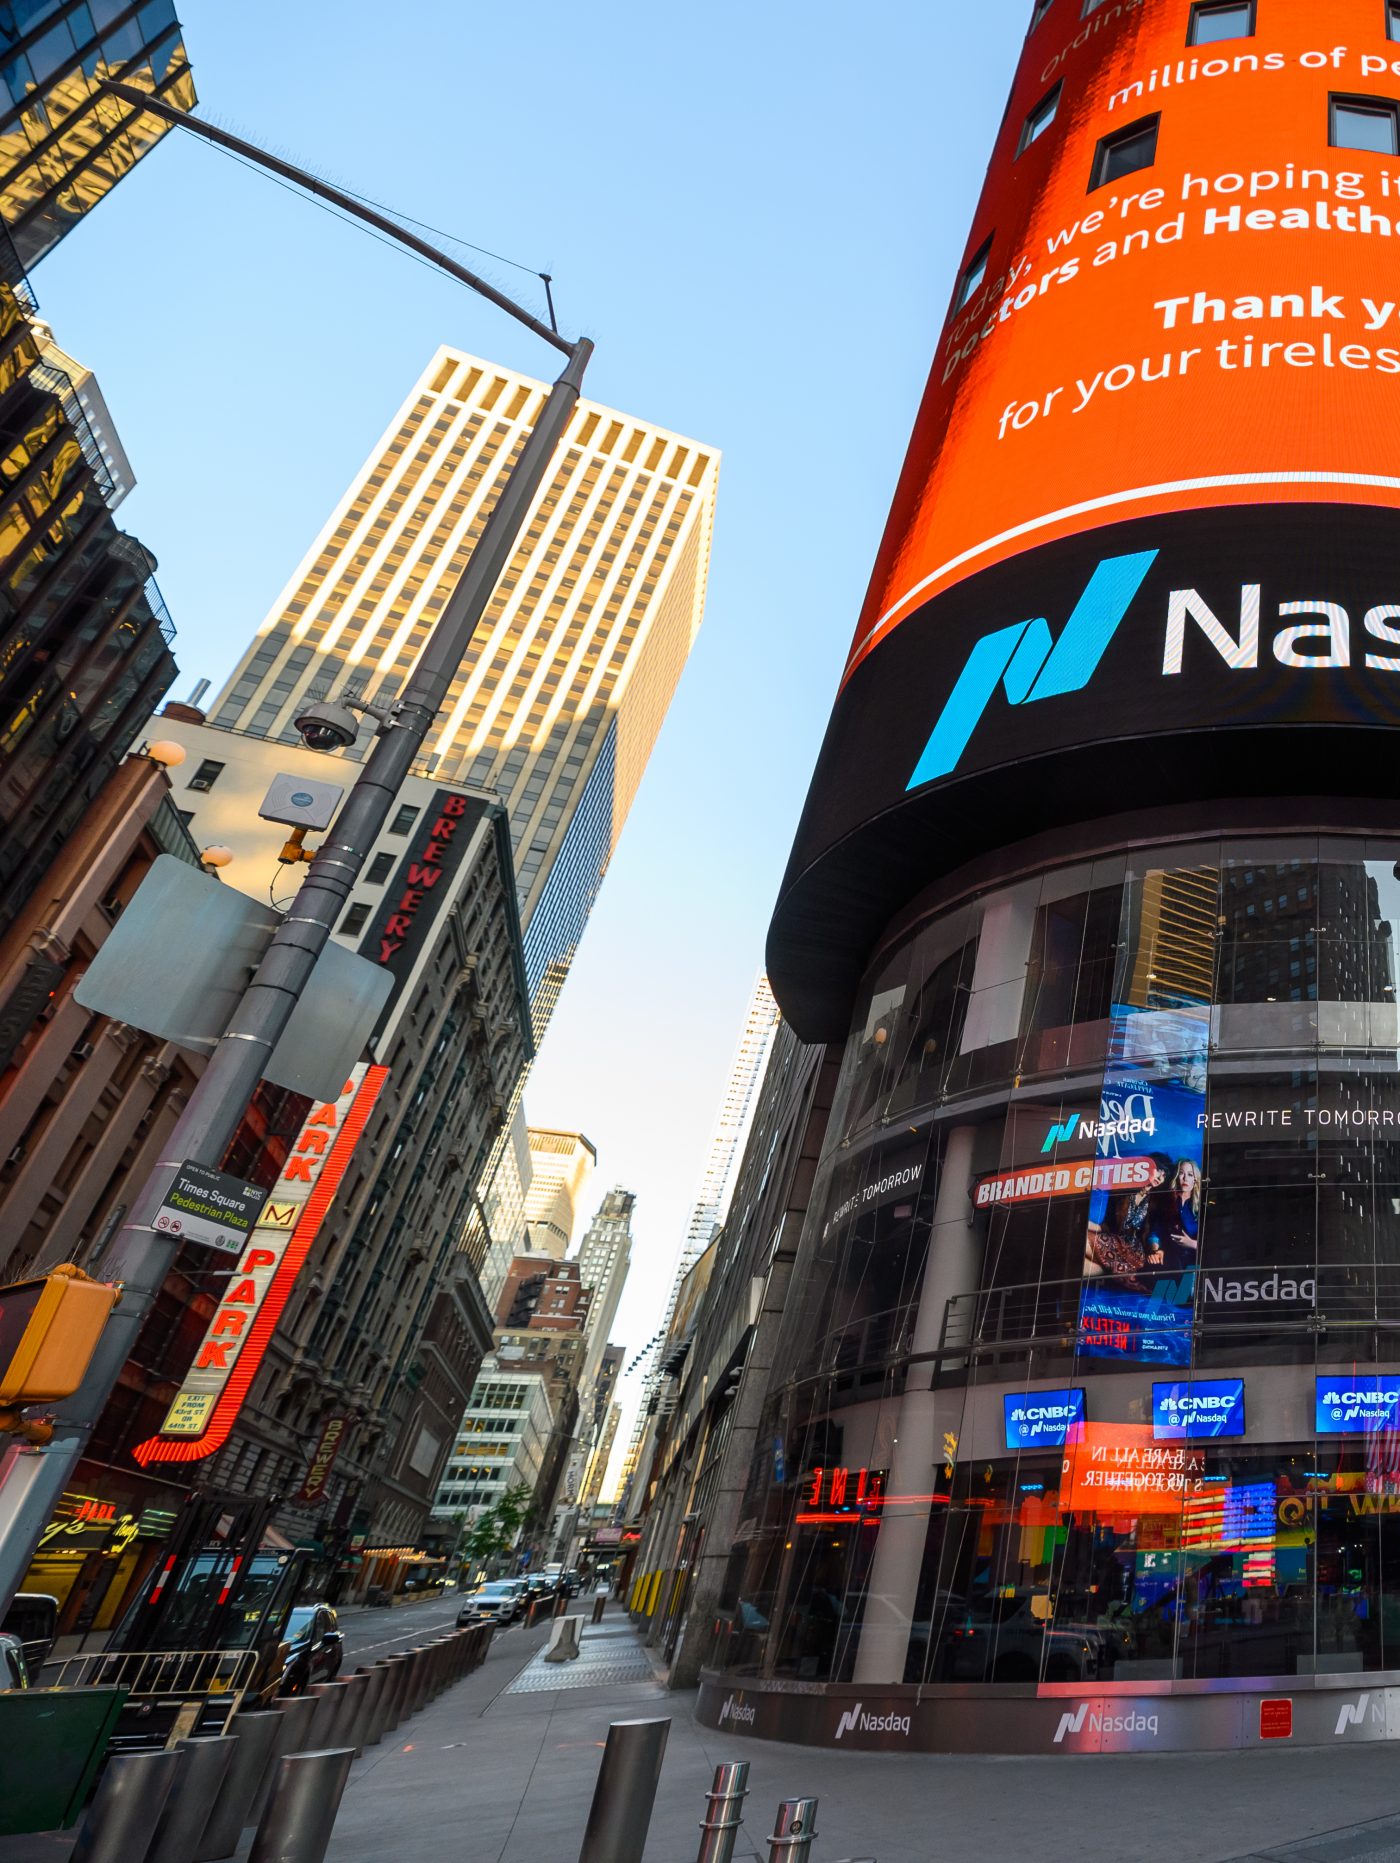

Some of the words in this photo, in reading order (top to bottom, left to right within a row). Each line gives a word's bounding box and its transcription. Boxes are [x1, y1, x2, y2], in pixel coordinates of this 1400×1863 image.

[1107, 52, 1285, 112] millions
[1300, 46, 1350, 69] of
[1046, 186, 1165, 254] we're
[1181, 162, 1366, 200] hoping
[941, 257, 1080, 387] Doctors
[1092, 212, 1185, 267] and
[1153, 285, 1346, 329] Thank
[997, 385, 1064, 440] for
[1073, 344, 1202, 413] your
[377, 794, 468, 966] BREWERY
[1078, 1116, 1156, 1140] Nasdaq
[1196, 1110, 1292, 1129] REWRITE
[186, 1164, 199, 1173] OPEN
[205, 1171, 221, 1181] PUBLIC
[862, 1164, 922, 1202] TOMORROW
[976, 1168, 1070, 1205] BRANDED
[1074, 1161, 1151, 1188] CITIES
[169, 1192, 223, 1219] Pedestrian
[223, 1210, 249, 1228] Plaza
[178, 1177, 209, 1198] Times
[209, 1190, 246, 1212] Square
[1204, 1273, 1316, 1308] Nasdaq
[196, 1249, 275, 1368] PARK
[1026, 1405, 1077, 1420] CNBC
[1177, 1395, 1236, 1410] CNBC
[1339, 1391, 1399, 1404] CNBC
[1359, 1408, 1390, 1419] Nasdaq
[1042, 1422, 1071, 1434] Nasdaq
[1196, 1413, 1227, 1424] Nasdaq
[304, 1420, 343, 1498] BREWERY
[729, 1703, 756, 1726] Nasdaq
[860, 1711, 911, 1737] Nasdaq
[1088, 1710, 1159, 1737] Nasdaq
